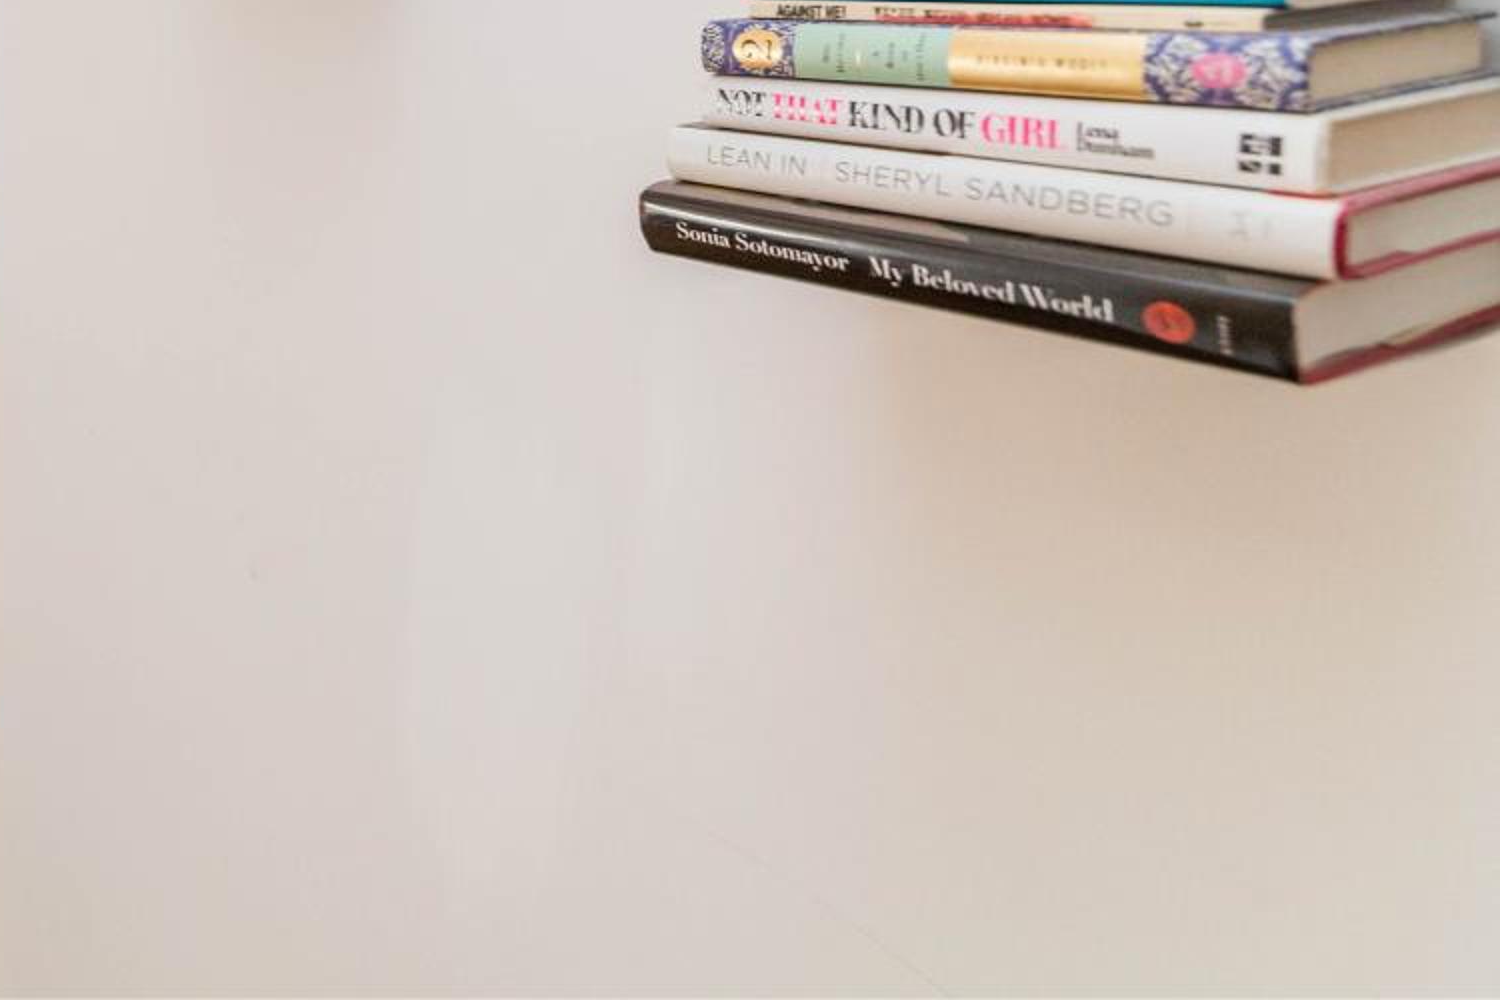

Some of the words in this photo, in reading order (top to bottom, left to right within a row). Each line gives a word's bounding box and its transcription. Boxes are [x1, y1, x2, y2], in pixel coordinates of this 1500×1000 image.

[717, 88, 767, 117] NOT
[771, 93, 847, 126] THAT
[848, 99, 926, 134] KIND
[932, 107, 977, 140] OF
[979, 110, 1067, 150] GIRL
[706, 144, 772, 171] LEAN
[780, 154, 808, 177] IN
[834, 161, 952, 199] SHERYL
[963, 176, 1175, 229] SANDBERG
[674, 221, 731, 249] Sonia
[733, 233, 850, 273] Sotomayor
[867, 255, 904, 287] My
[911, 262, 1016, 303] Beloved
[1018, 285, 1116, 324] World
